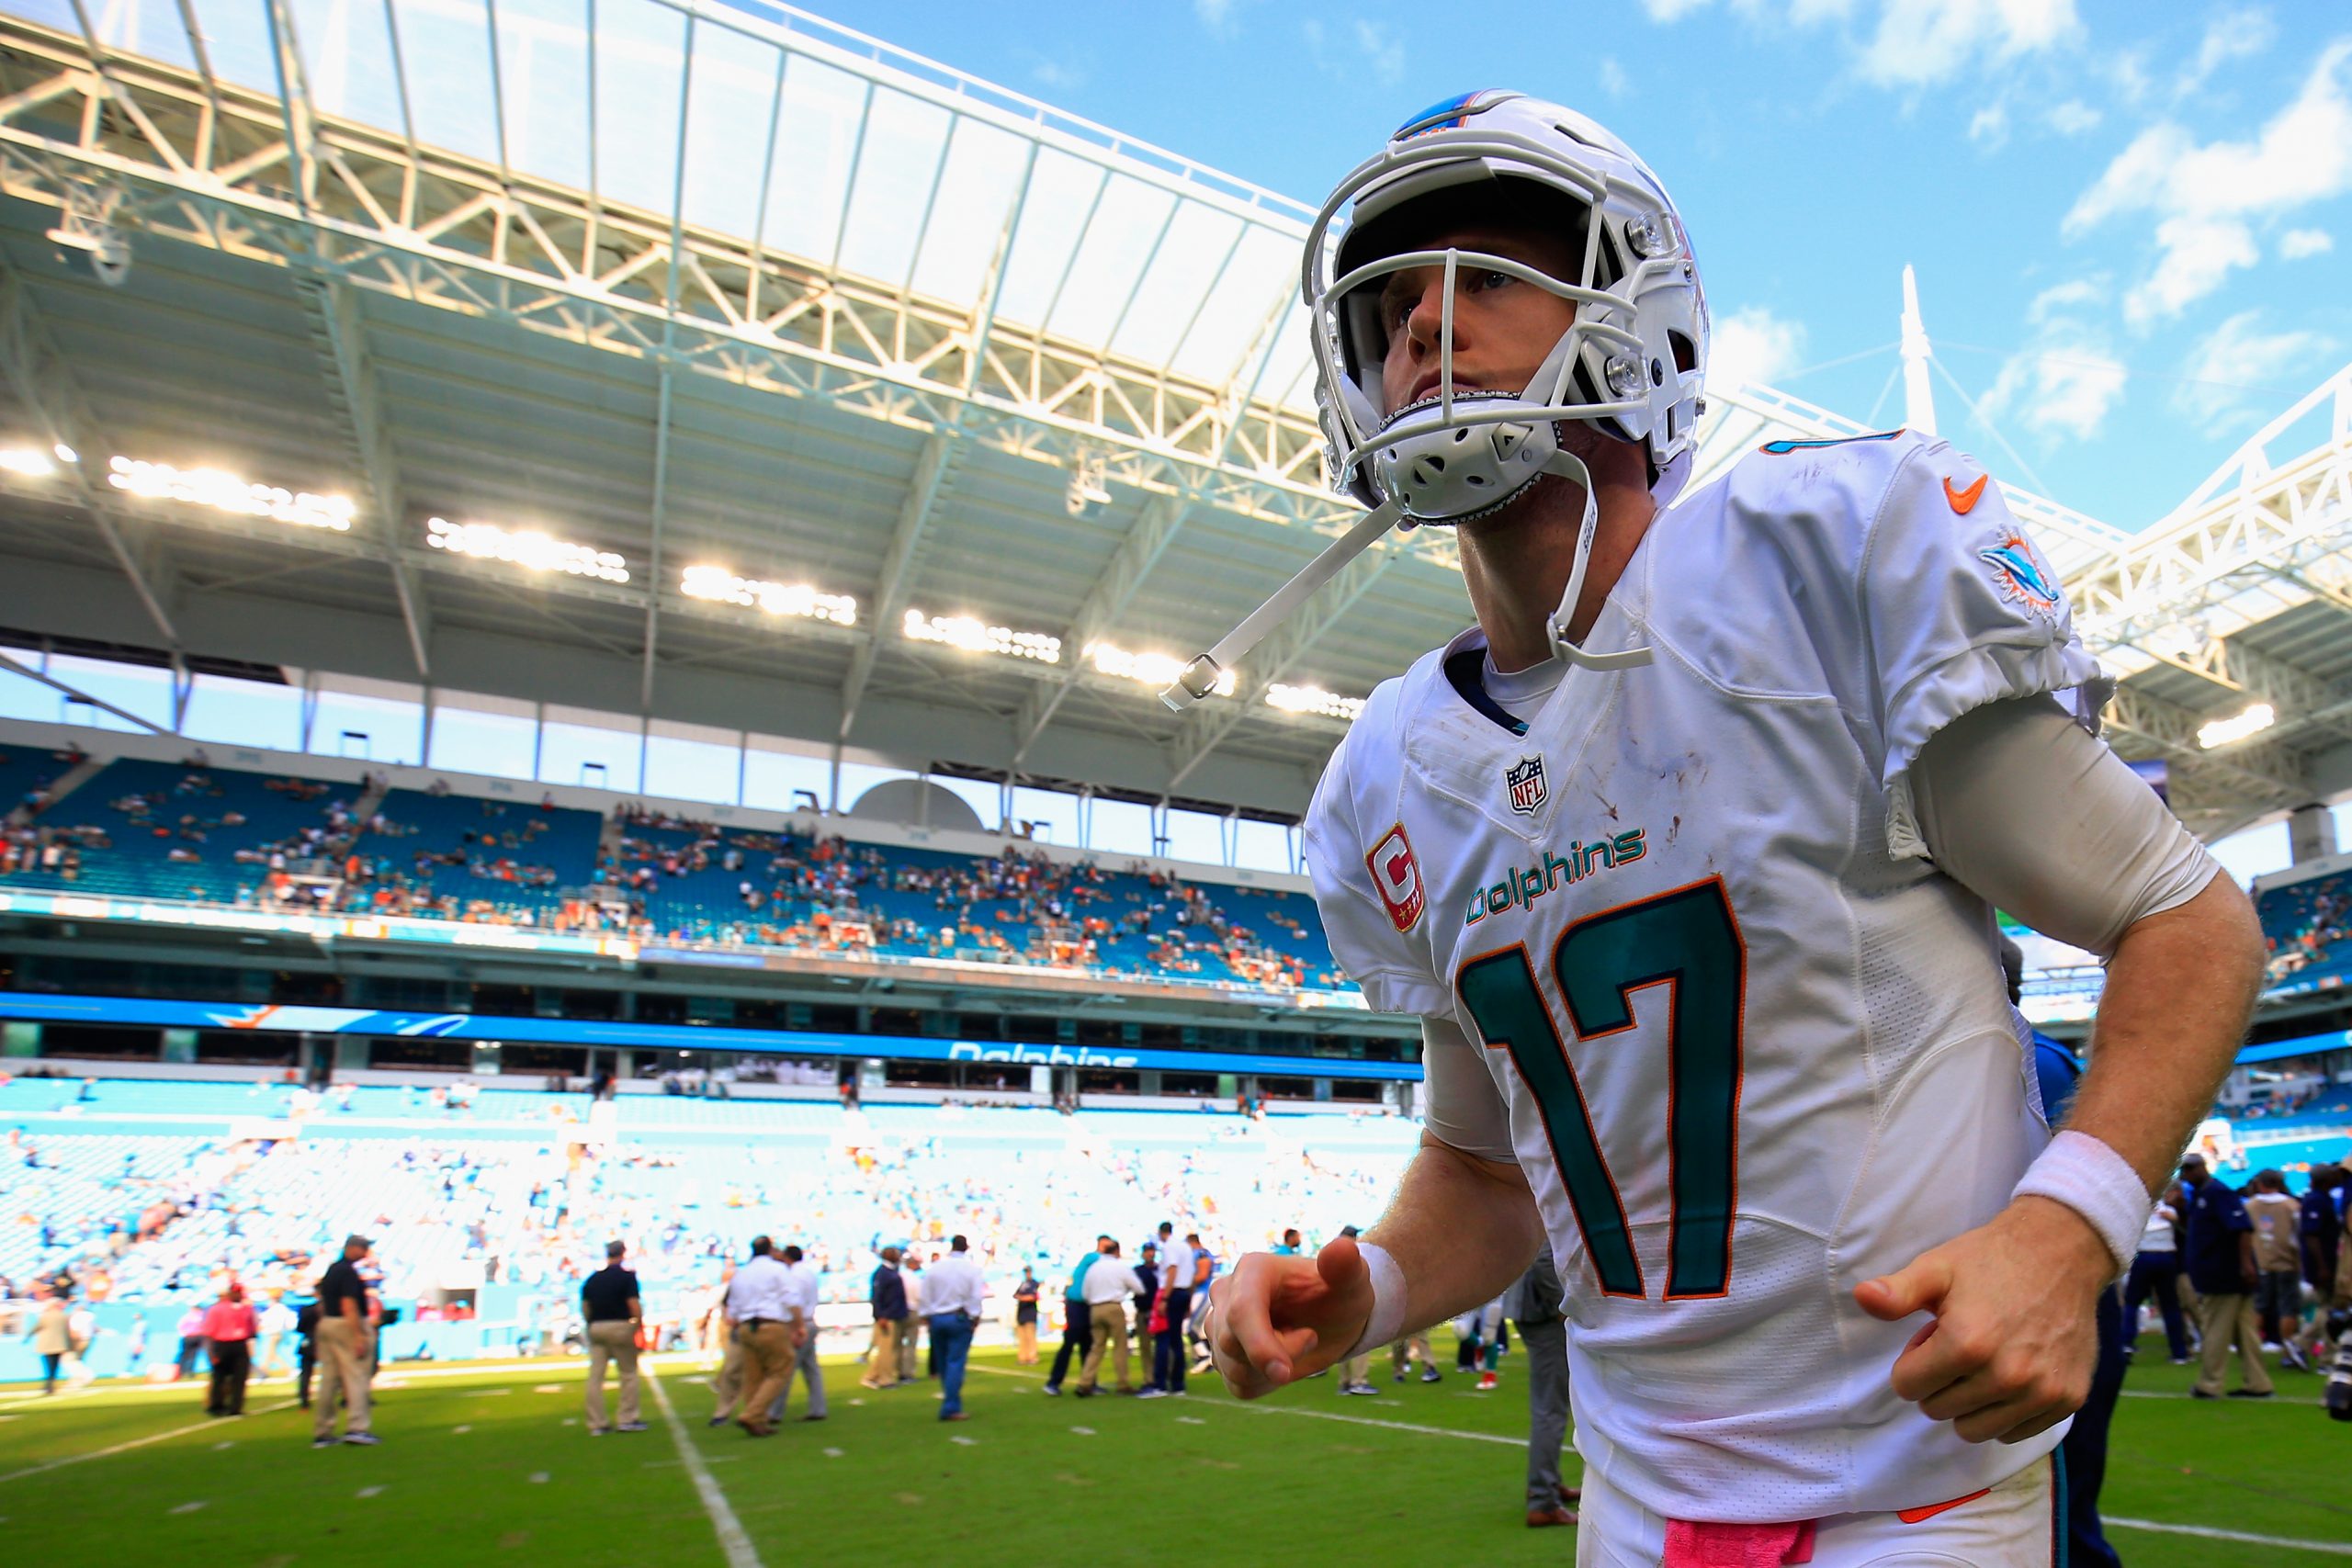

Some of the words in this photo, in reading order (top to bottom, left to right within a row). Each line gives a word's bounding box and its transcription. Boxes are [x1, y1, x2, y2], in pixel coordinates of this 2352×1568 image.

[1513, 778, 1544, 807] NFL
[1374, 834, 1416, 906] C
[1465, 828, 1647, 927] Dolphins
[1455, 874, 1747, 1302] 17
